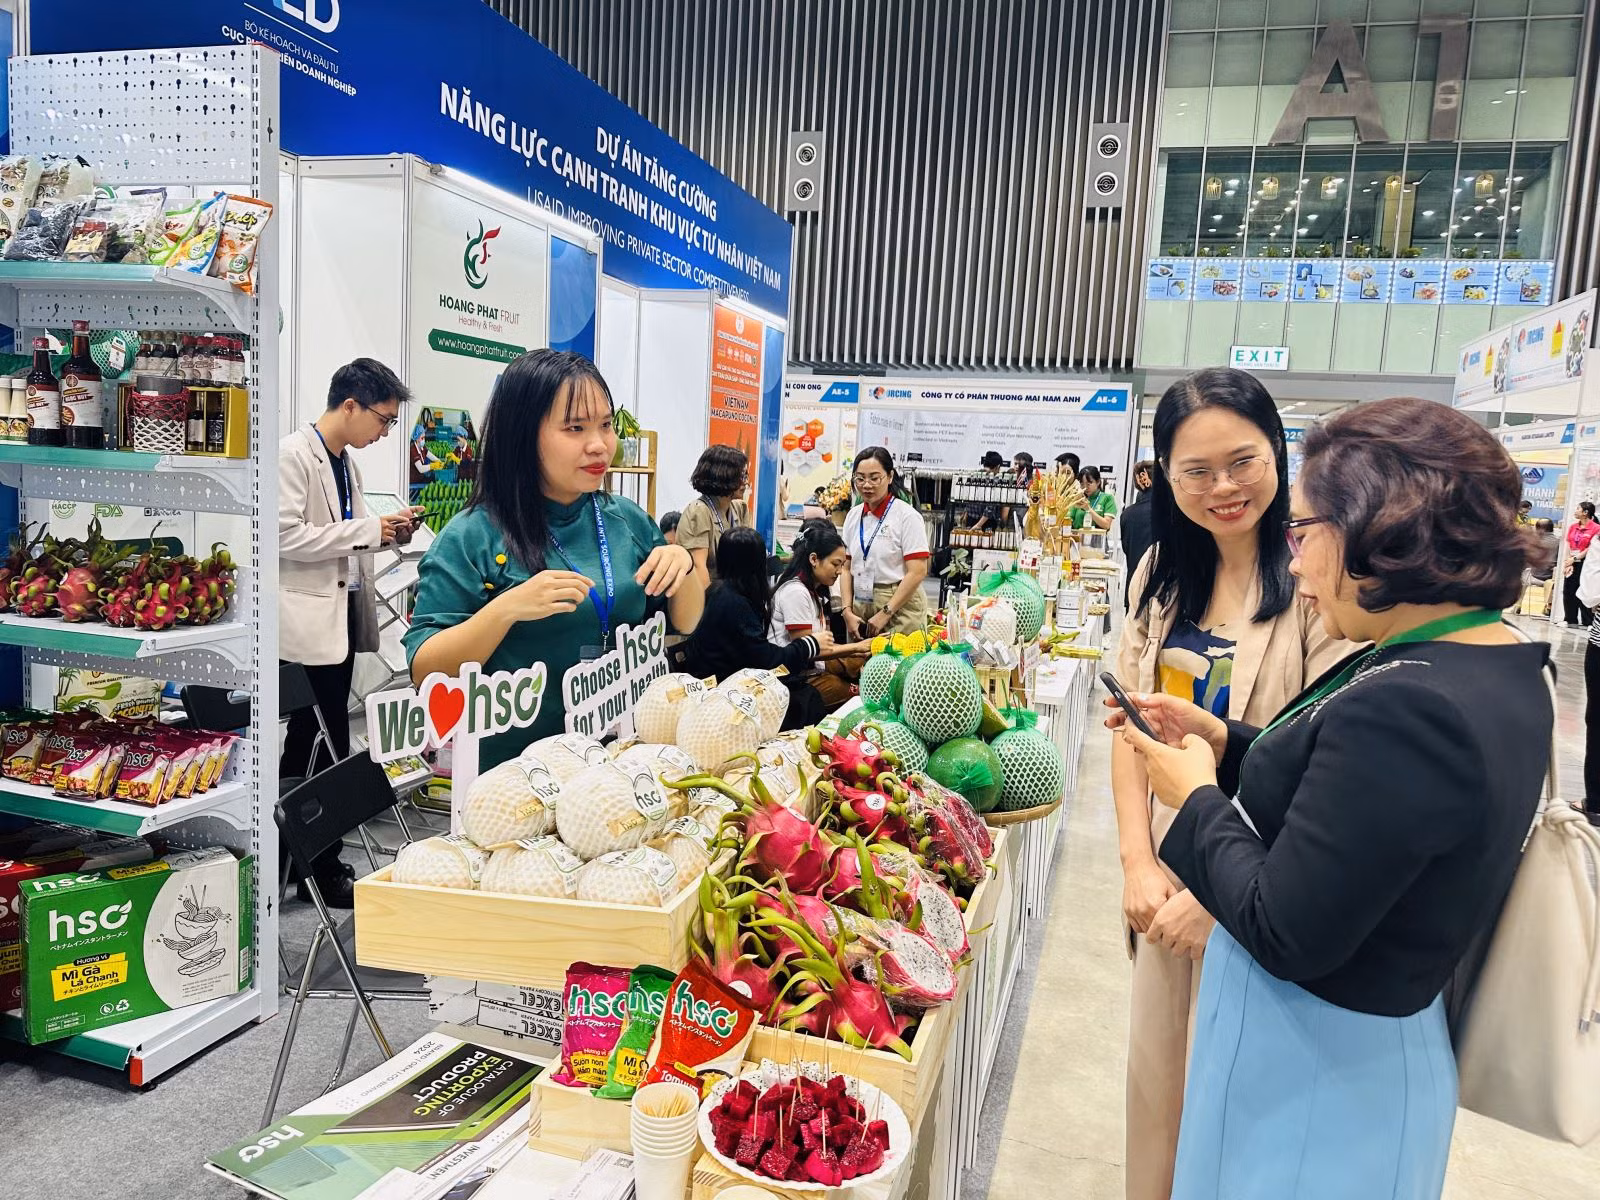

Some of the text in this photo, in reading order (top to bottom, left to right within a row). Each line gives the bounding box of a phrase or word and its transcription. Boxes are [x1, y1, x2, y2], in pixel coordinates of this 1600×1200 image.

[296, 60, 327, 83] DOANH
[327, 76, 357, 97] NGHIỆP
[440, 81, 781, 291] NĂNG LỰC CẠNH TRANH KHU VỰC TƯ NHÂN VIỆT NAM
[596, 126, 717, 222] DỰ ÁN TĂNG CƯỜNG
[527, 186, 565, 218] USAID
[567, 206, 625, 249] IMPROVING
[627, 234, 661, 266] PRIVATE
[661, 252, 692, 280] SECTOR
[439, 294, 520, 326] HOANG PHAT FRUIT
[458, 315, 481, 330] Healthy
[488, 321, 503, 333] Fresh
[1235, 350, 1284, 362] EXIT
[724, 396, 749, 410] VIETNAM
[1042, 395, 1061, 403] NAM
[601, 544, 613, 577] SOURCING
[606, 577, 614, 597] EXPO
[570, 622, 664, 707] Choose hsc
[377, 671, 543, 755] We hsc
[597, 688, 627, 732] your
[530, 782, 560, 799] hsc
[634, 787, 662, 810] hsc
[32, 873, 100, 892] hsc
[49, 900, 133, 943] hsc
[62, 964, 101, 982] Mì Gà
[71, 971, 119, 988] Lá Chanh
[519, 991, 561, 1012] EXCEL
[629, 983, 667, 1018] hs
[673, 979, 739, 1039] hsc
[521, 1019, 562, 1041] EXCEL
[535, 1017, 563, 1028] PHOTOCOPY
[413, 1041, 436, 1055] 2024
[624, 1055, 637, 1068] Mì
[413, 1050, 488, 1102] PRODUCT
[591, 1058, 604, 1067] non
[413, 1055, 502, 1116] EXPORTING
[438, 1060, 514, 1117] CATALOGUE OF
[238, 1124, 305, 1164] hsc
